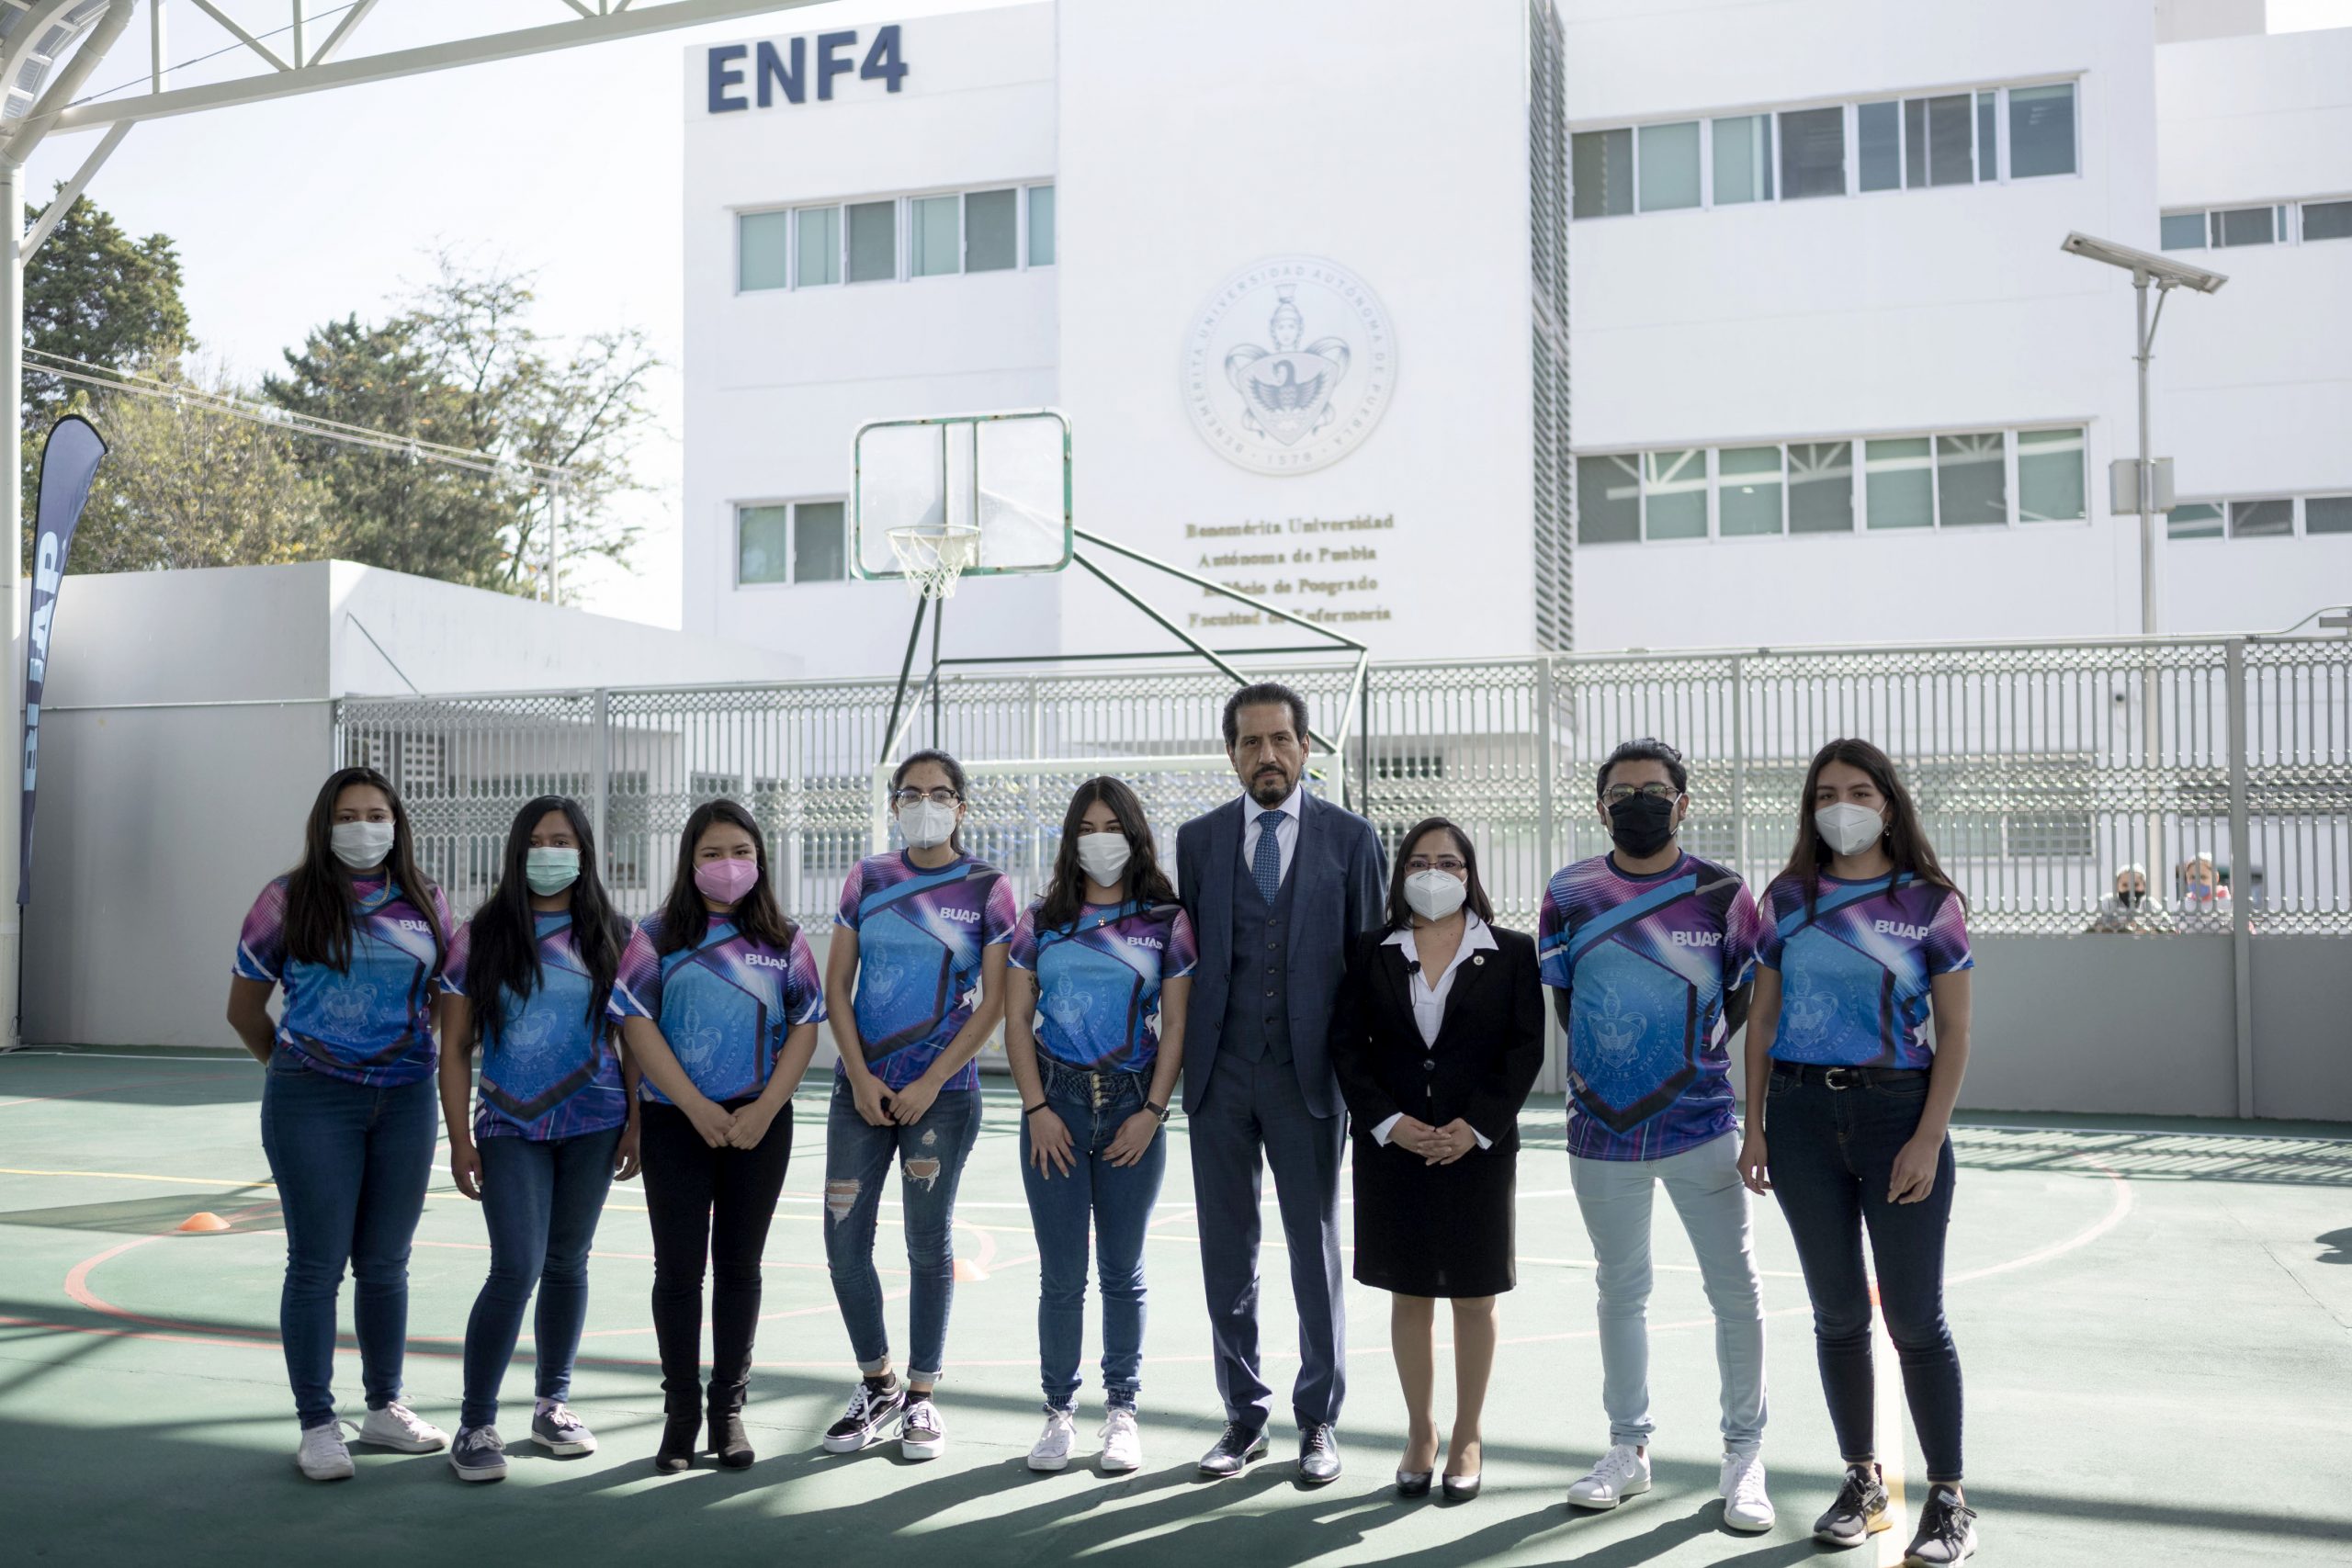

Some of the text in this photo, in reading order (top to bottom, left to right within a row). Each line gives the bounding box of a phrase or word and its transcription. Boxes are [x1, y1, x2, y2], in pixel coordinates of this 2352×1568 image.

[707, 24, 910, 114] ENF4
[1185, 513, 1395, 539] Benemérita Universidad
[1198, 545, 1377, 569] Autónoma de Puebla
[1273, 580, 1292, 594] de
[940, 907, 981, 924] BUAP
[1672, 931, 1723, 947] BUAP
[1873, 919, 1928, 942] BUAP
[1126, 936, 1164, 951] BUAP
[745, 953, 788, 971] BUAP
